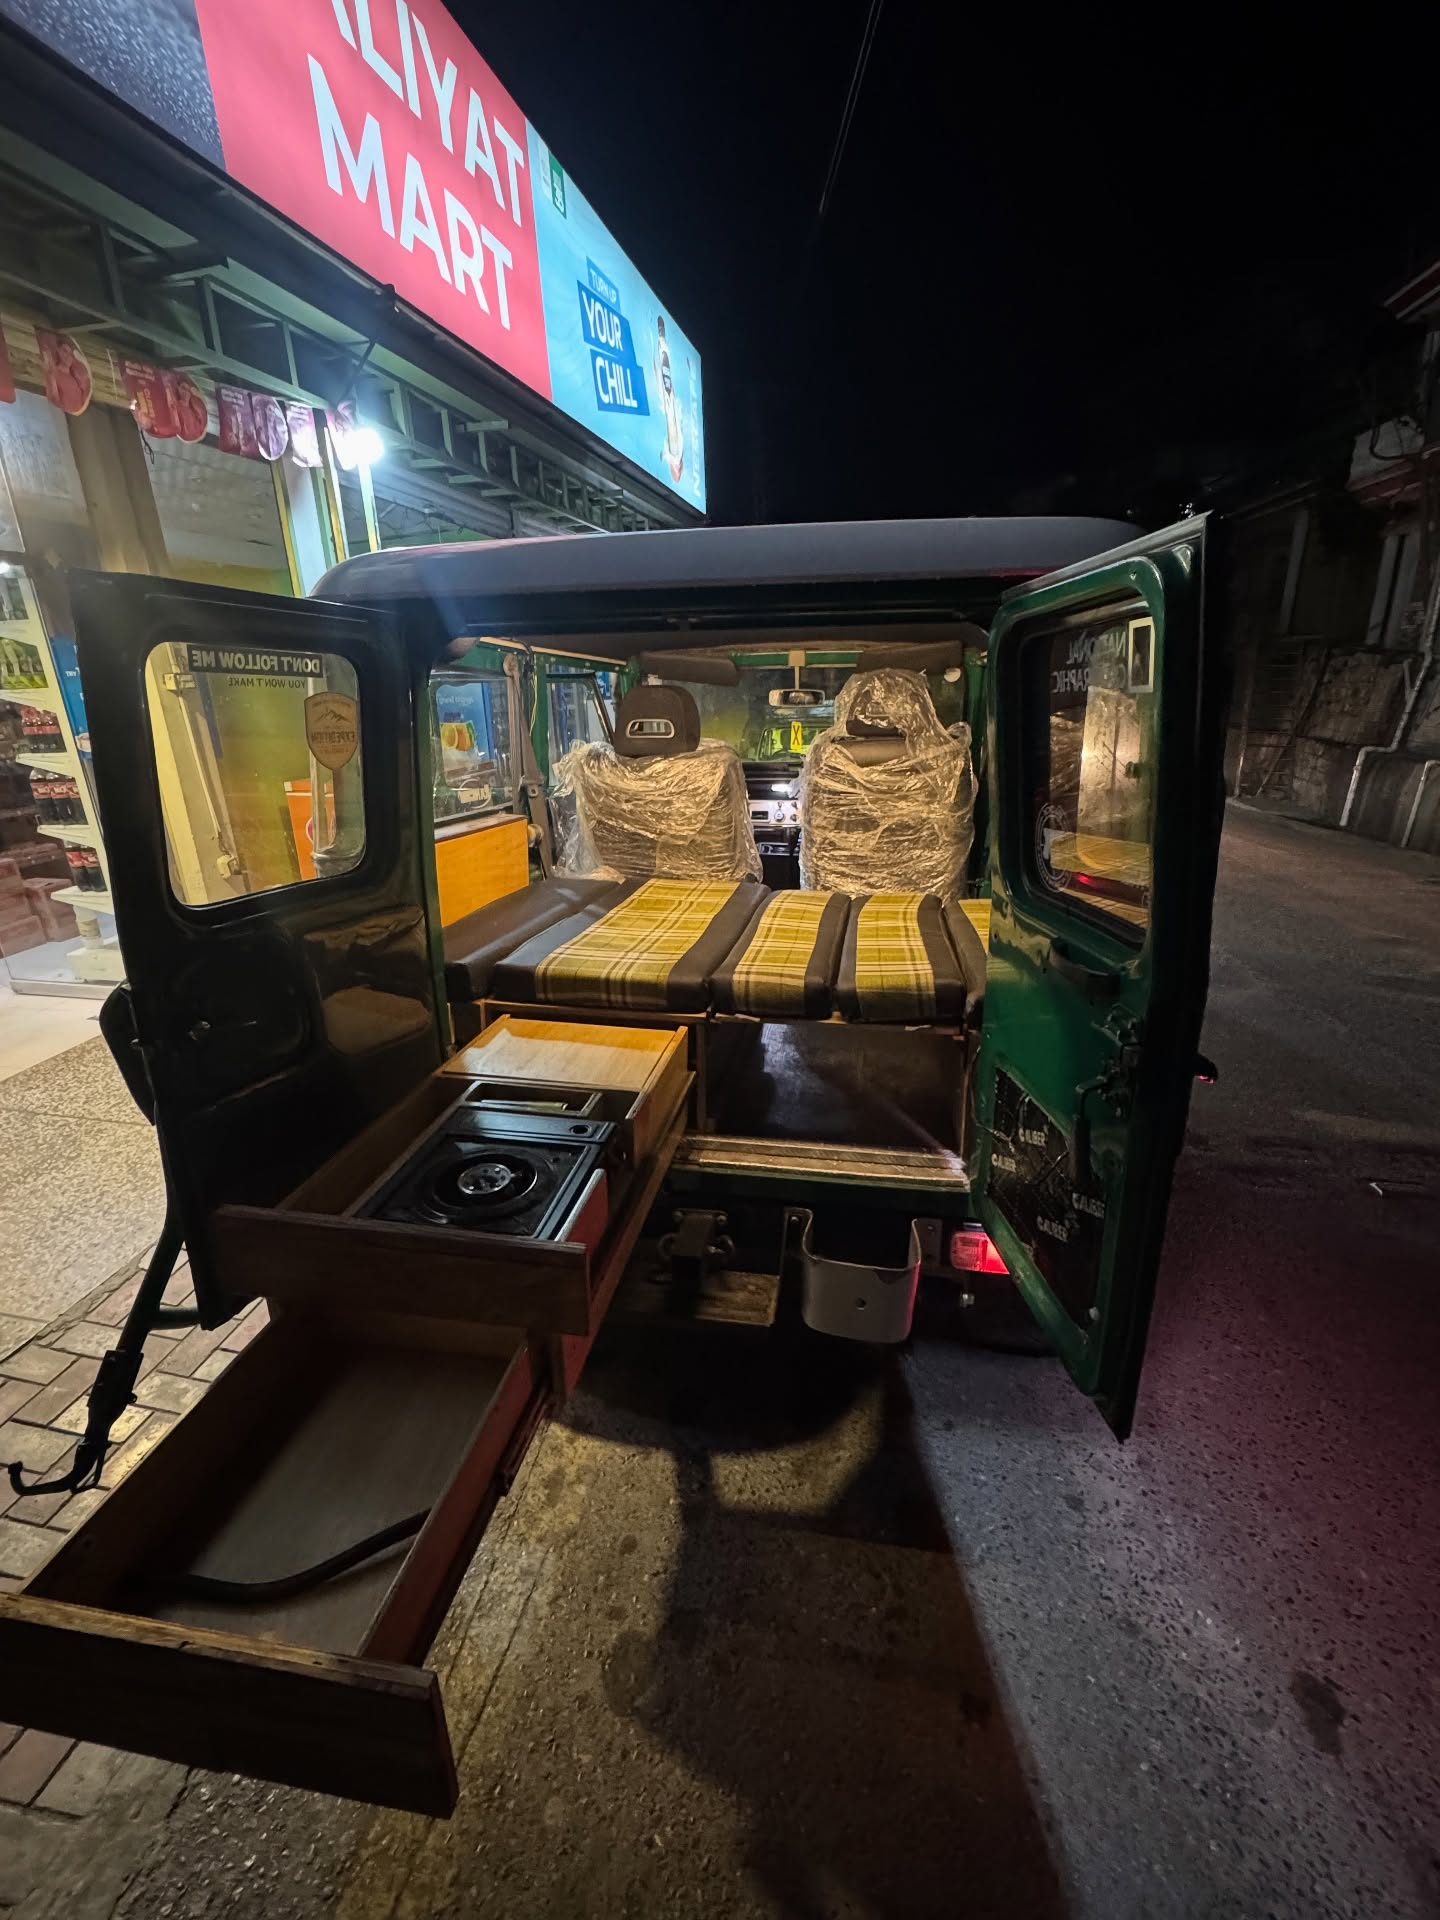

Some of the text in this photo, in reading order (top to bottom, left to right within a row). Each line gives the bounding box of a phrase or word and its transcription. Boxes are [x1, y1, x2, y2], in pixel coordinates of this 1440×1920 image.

[306, 53, 513, 331] MART
[582, 290, 623, 352] YOUR
[595, 356, 638, 409] CHILL
